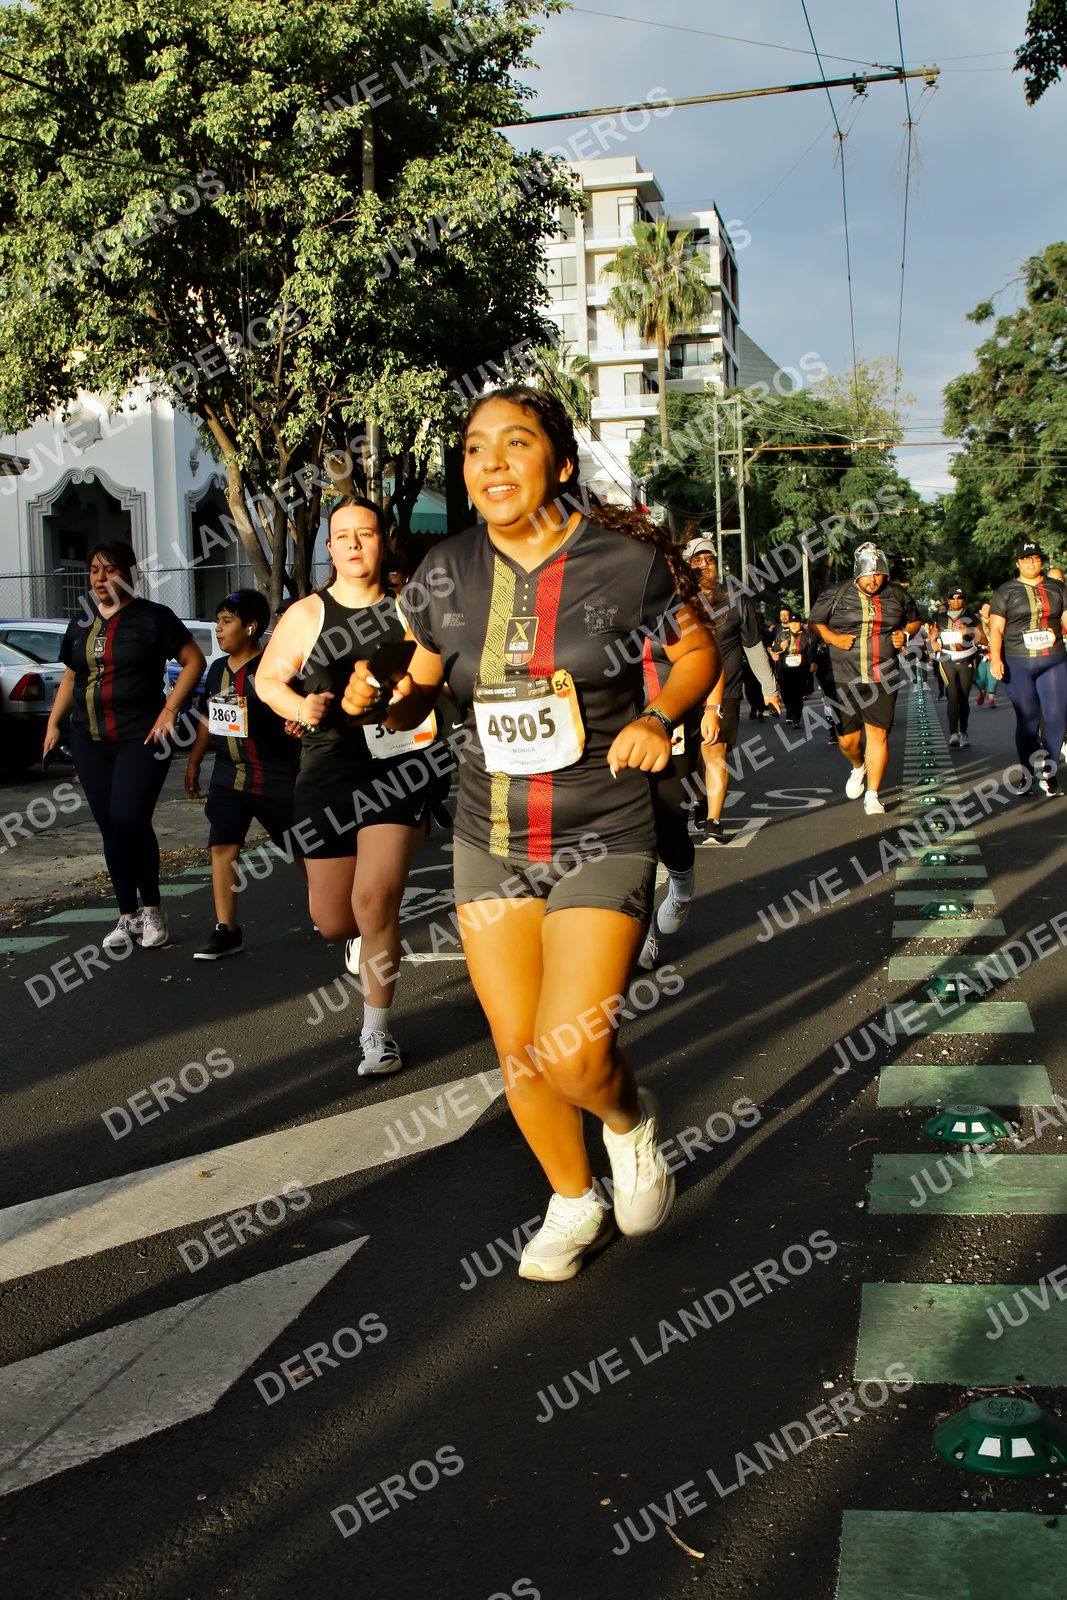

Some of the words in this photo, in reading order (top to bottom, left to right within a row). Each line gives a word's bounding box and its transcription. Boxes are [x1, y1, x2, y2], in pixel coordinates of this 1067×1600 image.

[1029, 634, 1049, 643] 1964
[212, 707, 237, 723] 2869
[487, 707, 556, 743] 4905
